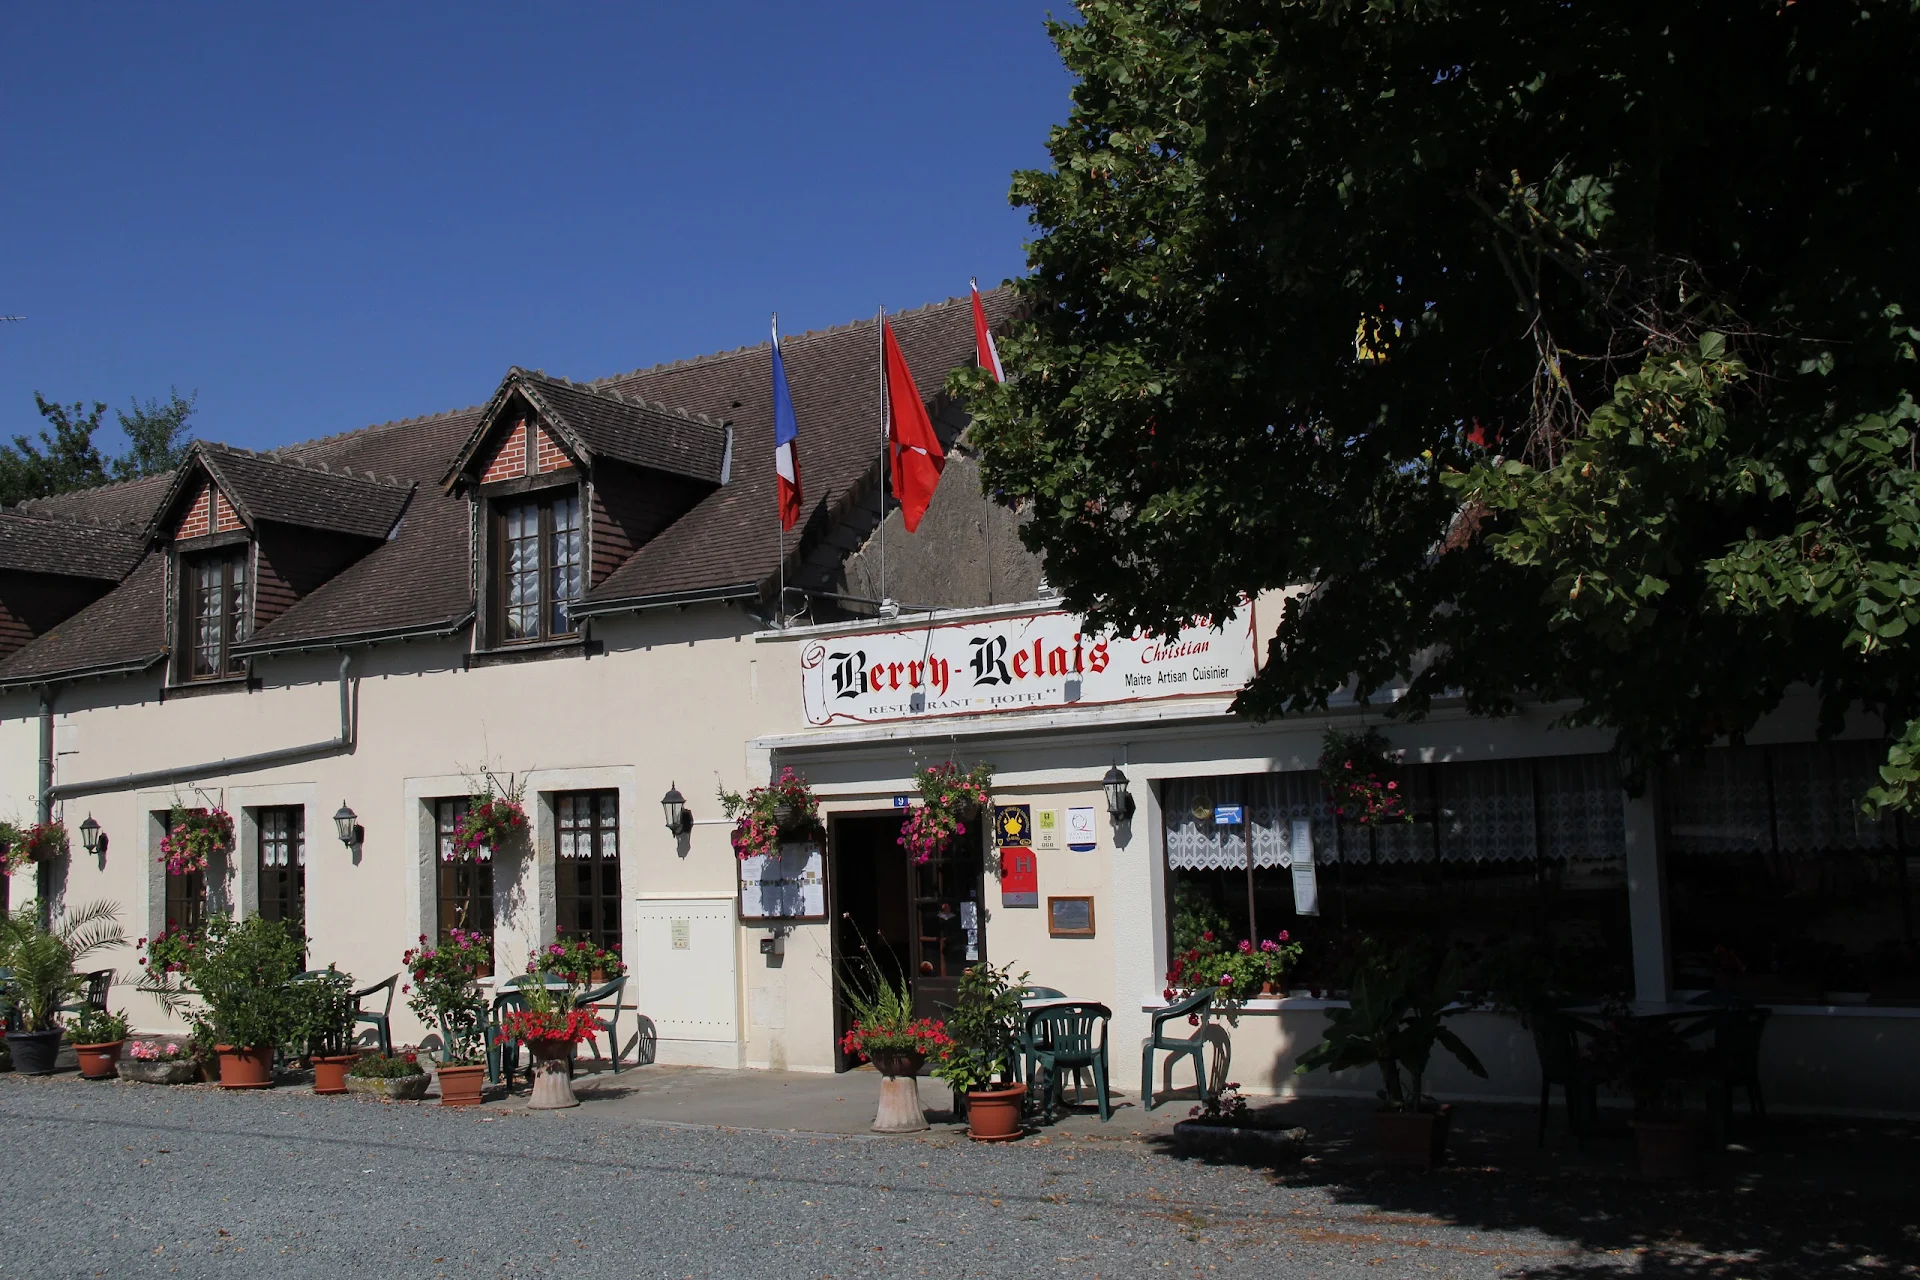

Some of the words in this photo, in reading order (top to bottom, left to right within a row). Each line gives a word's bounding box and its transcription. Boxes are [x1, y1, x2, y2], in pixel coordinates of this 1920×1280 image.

[1141, 641, 1209, 664] Christian
[1125, 673, 1152, 687] Maitre
[1157, 669, 1187, 684] Artisan
[1192, 665, 1229, 681] Cuisinier
[868, 698, 972, 714] RESTAURANT
[898, 797, 904, 806] 9
[1016, 856, 1031, 873] H
